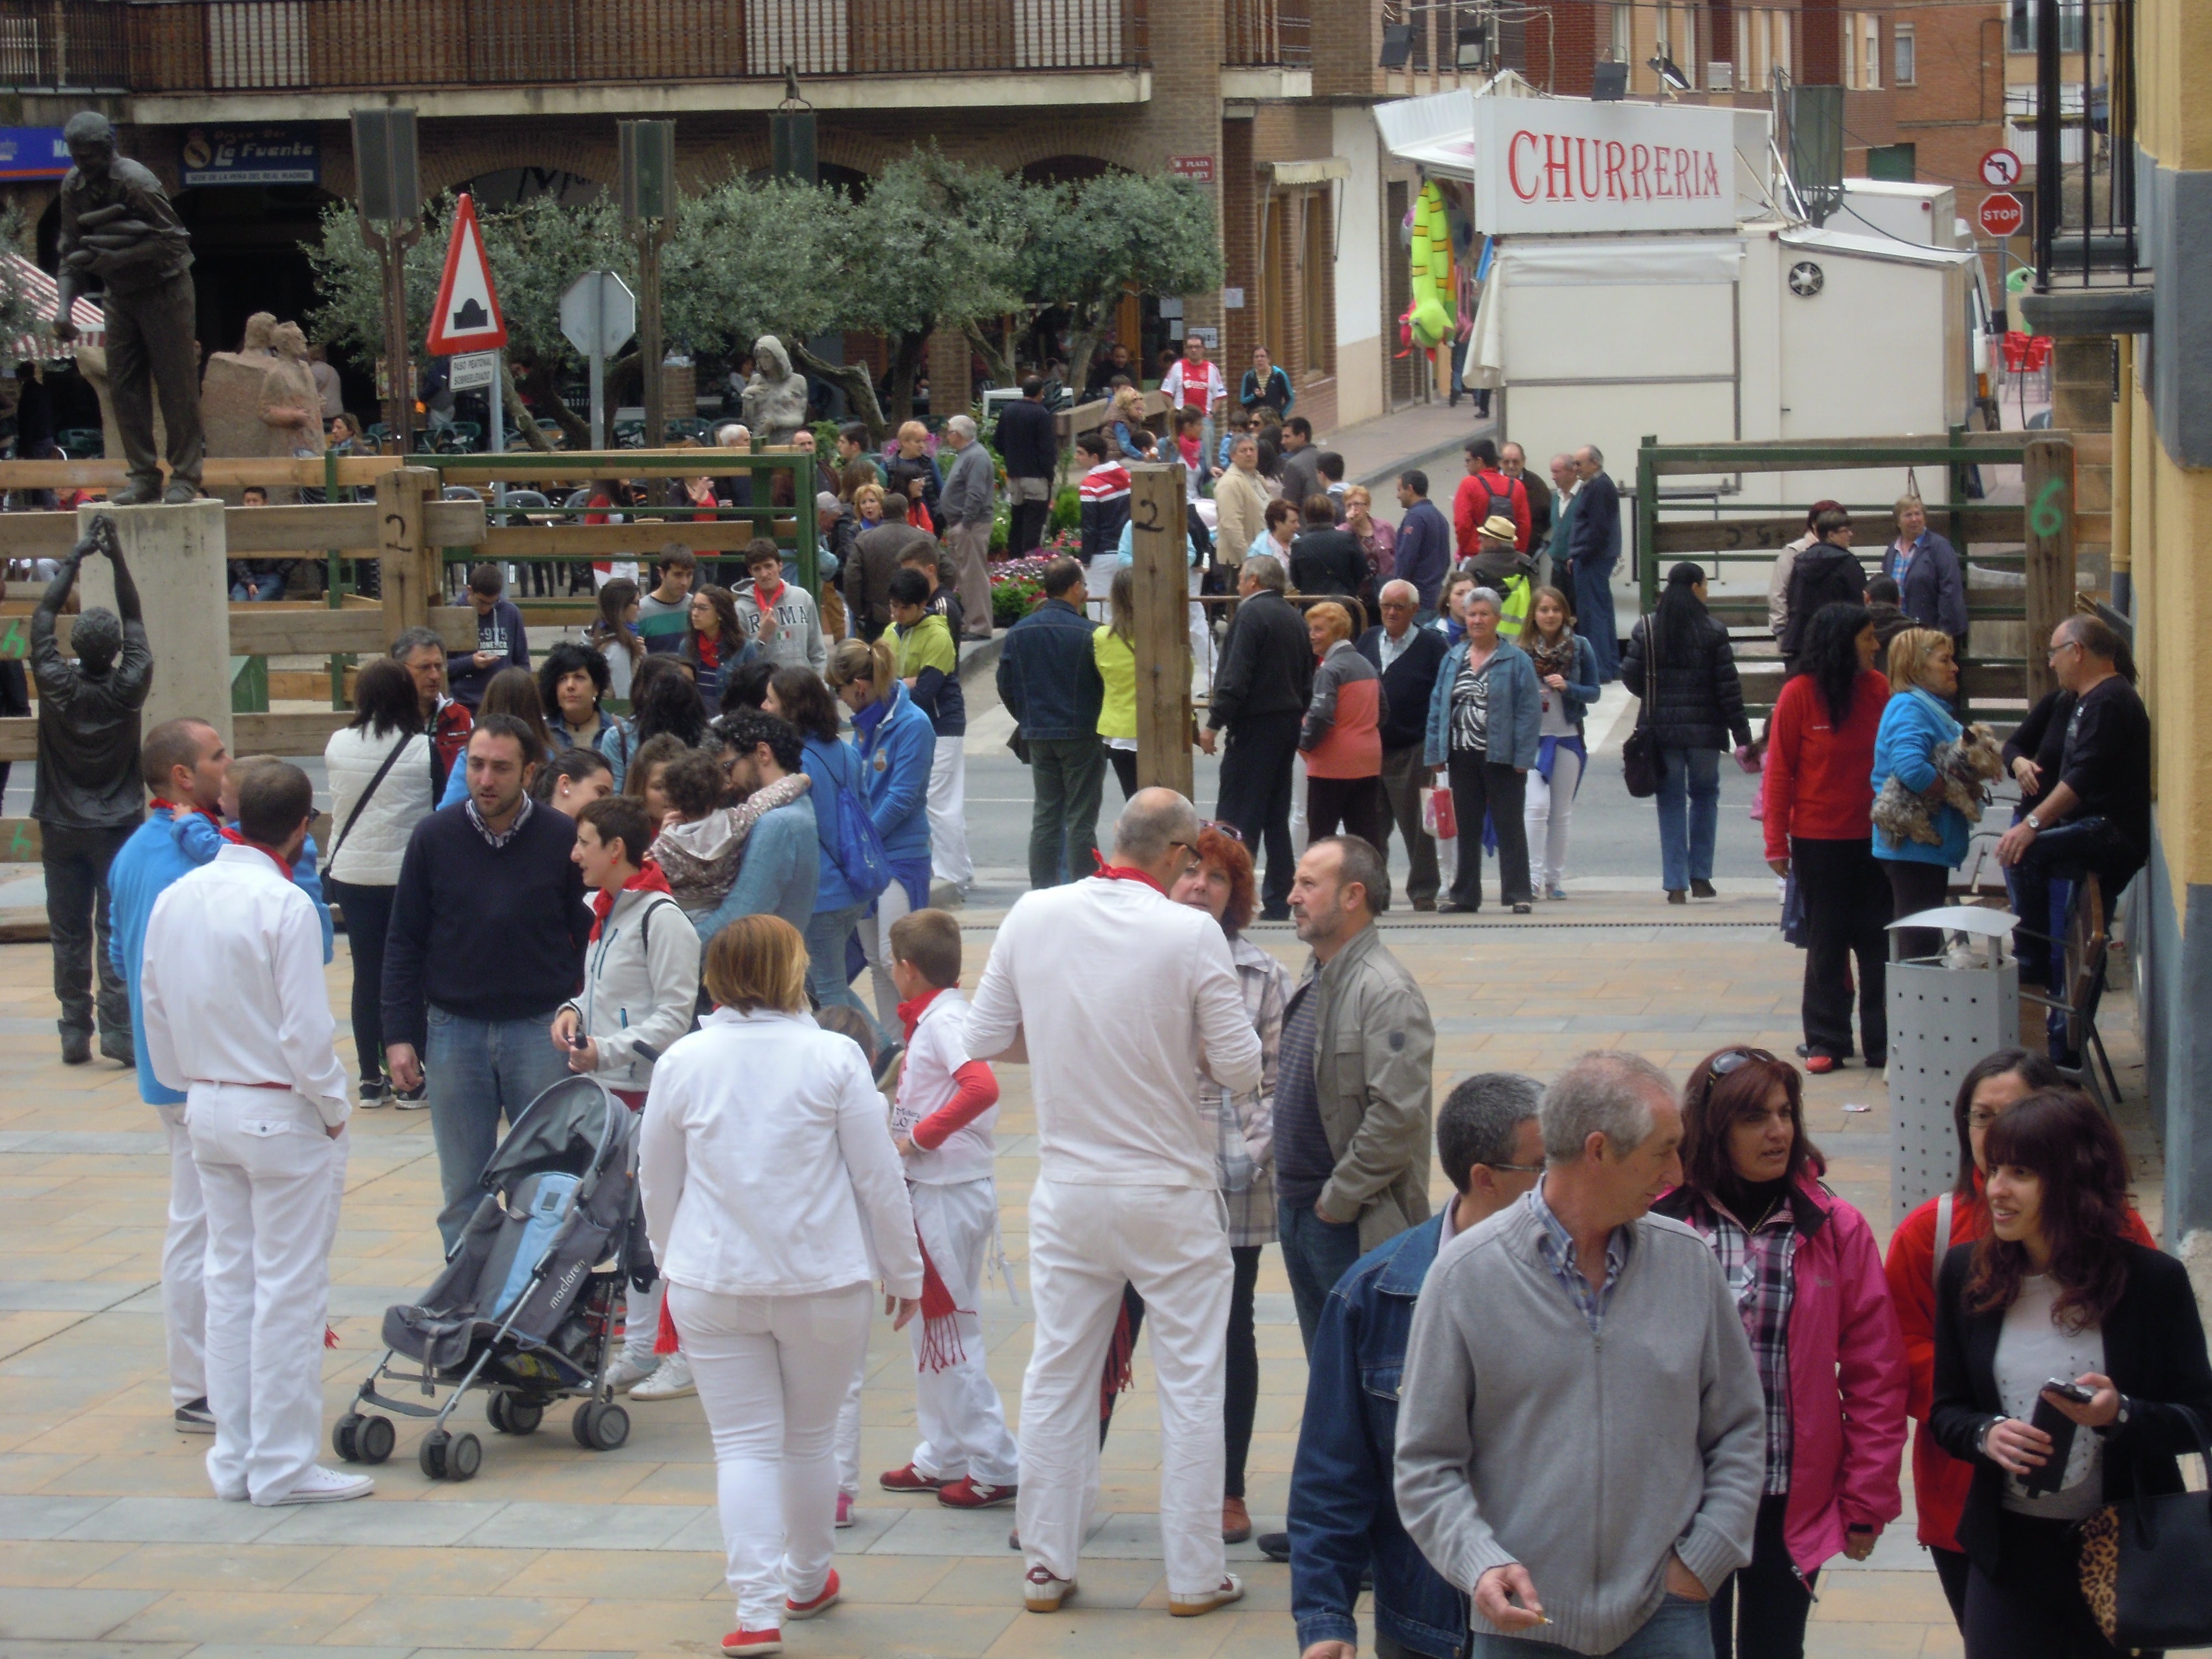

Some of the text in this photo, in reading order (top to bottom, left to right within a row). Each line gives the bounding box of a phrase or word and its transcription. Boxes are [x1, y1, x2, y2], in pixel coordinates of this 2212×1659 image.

[242, 141, 314, 157] Fuente
[1508, 129, 1721, 204] CHURRERIA
[1983, 210, 2018, 220] STOP
[1135, 499, 1165, 532] 2
[2030, 476, 2063, 537] 6
[385, 514, 413, 552] 2
[748, 605, 807, 634] RMA
[550, 1260, 586, 1310] maclaren
